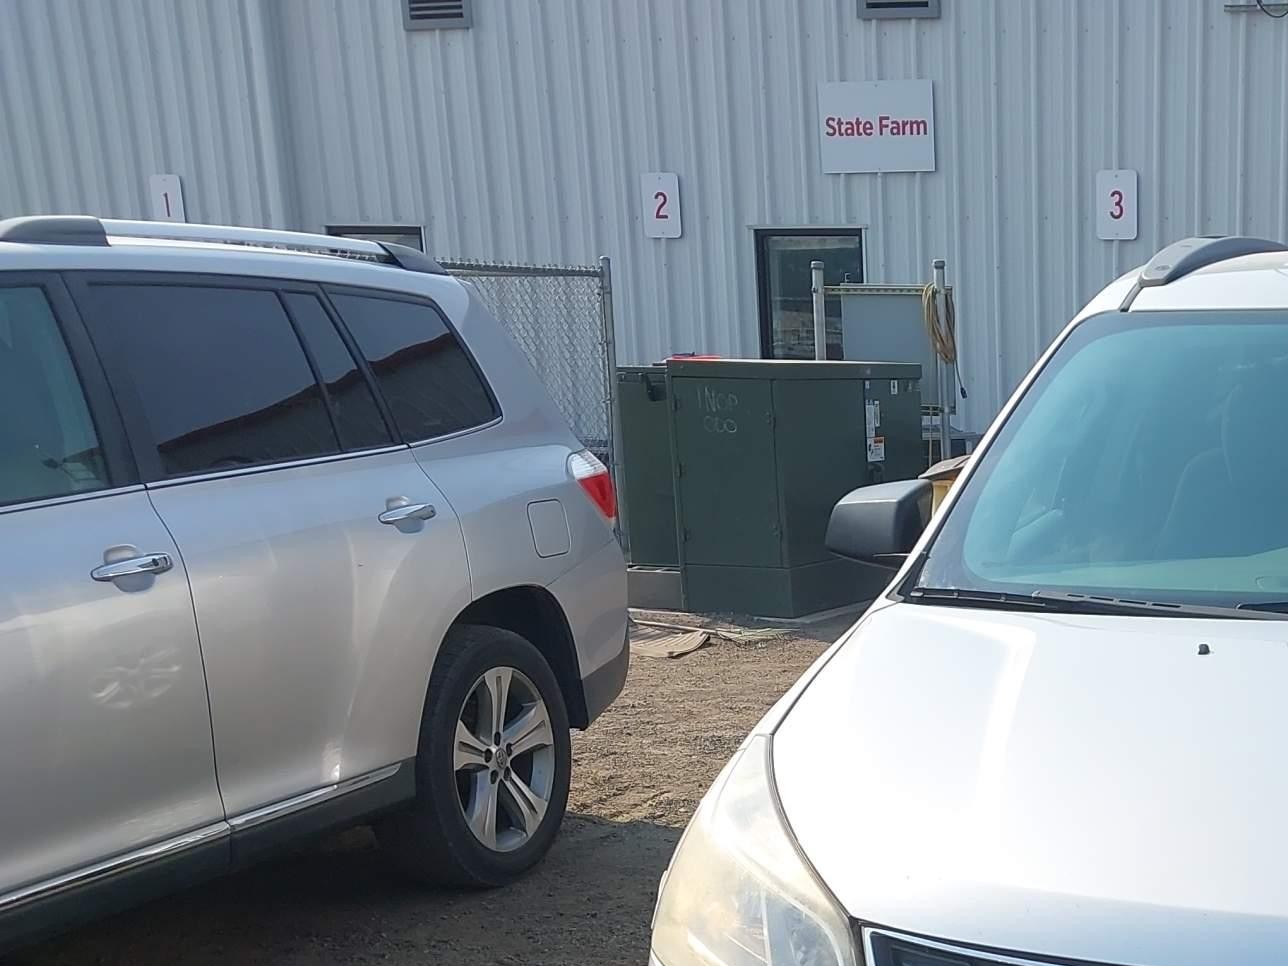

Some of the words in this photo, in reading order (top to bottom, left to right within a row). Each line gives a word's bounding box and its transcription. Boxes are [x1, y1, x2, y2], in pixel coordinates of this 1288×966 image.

[825, 116, 874, 137] State
[878, 115, 928, 136] Farm
[162, 191, 171, 218] 1
[654, 191, 669, 219] 2
[1109, 190, 1124, 220] 3
